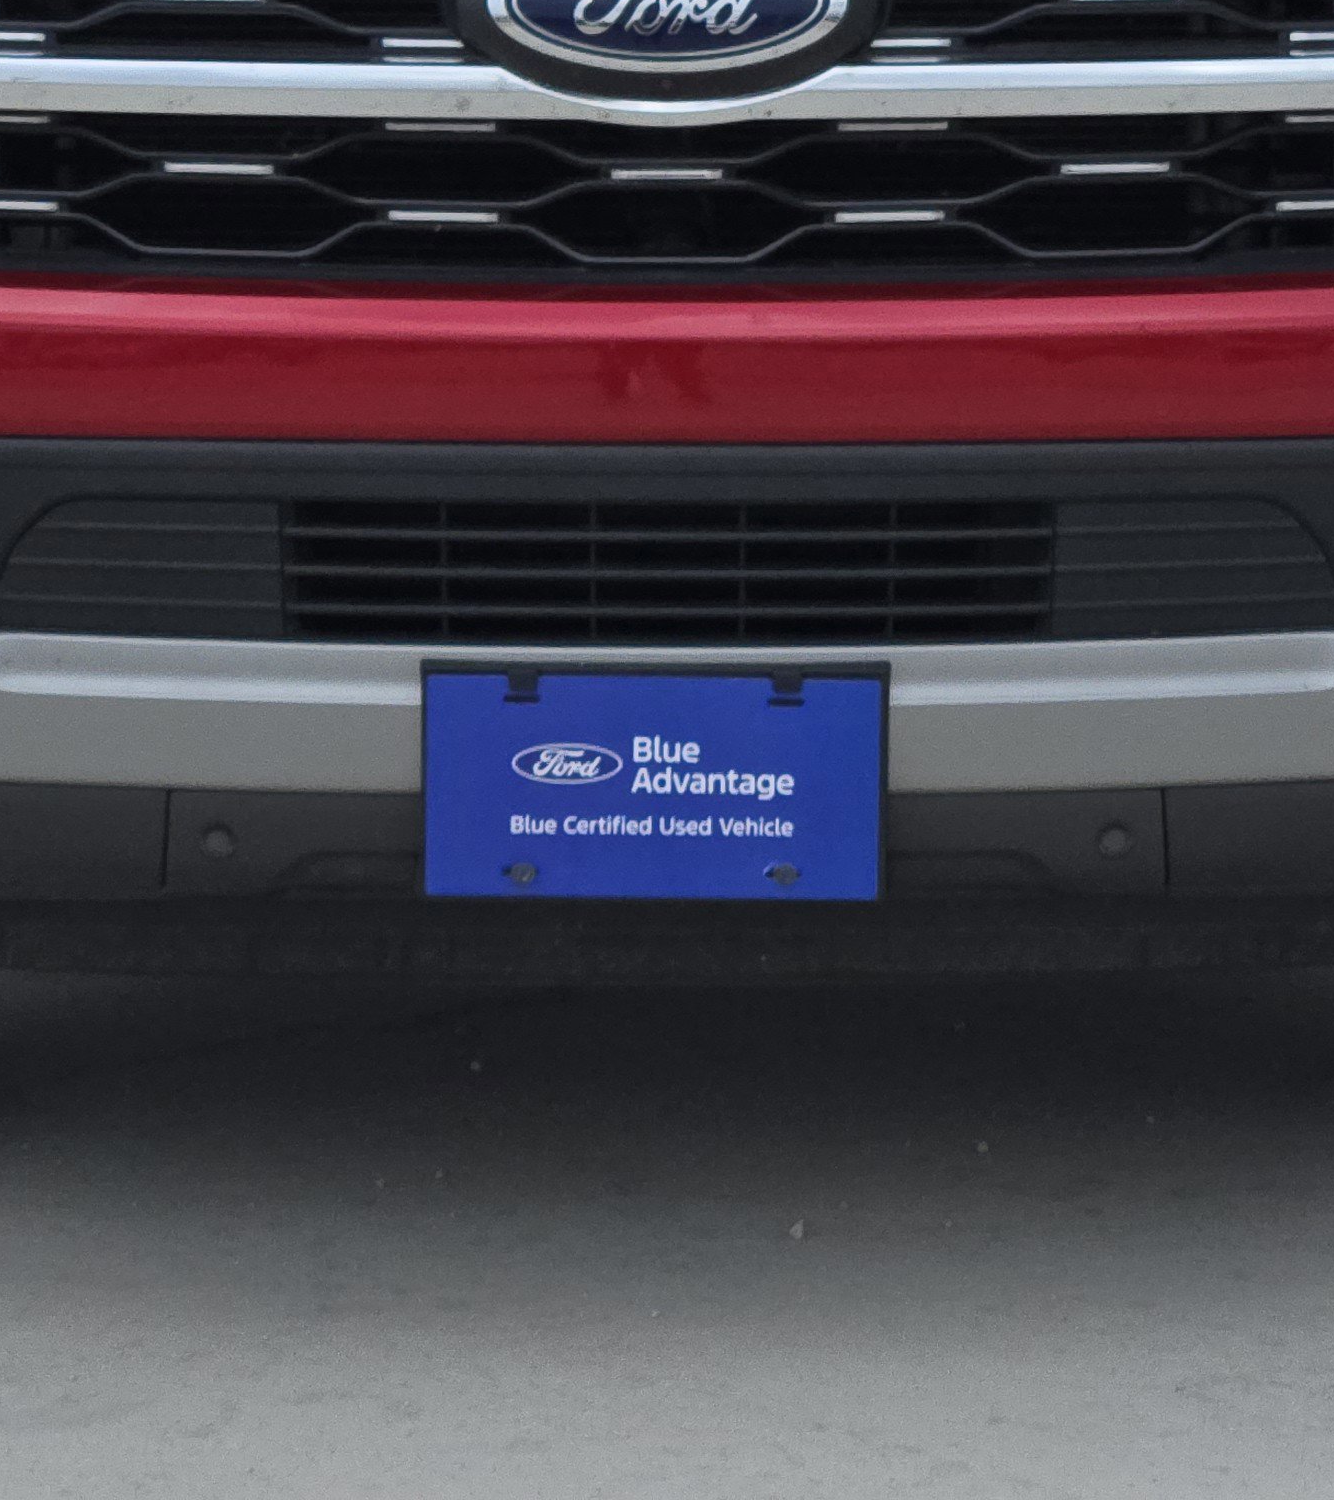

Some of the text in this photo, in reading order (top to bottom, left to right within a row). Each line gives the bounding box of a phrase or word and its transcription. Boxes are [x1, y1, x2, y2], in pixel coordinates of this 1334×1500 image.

[531, 748, 601, 780] Ford
[631, 734, 701, 764] Blue
[630, 766, 795, 801] Advantage
[509, 814, 794, 838] Blue Certified Used Vehicle
